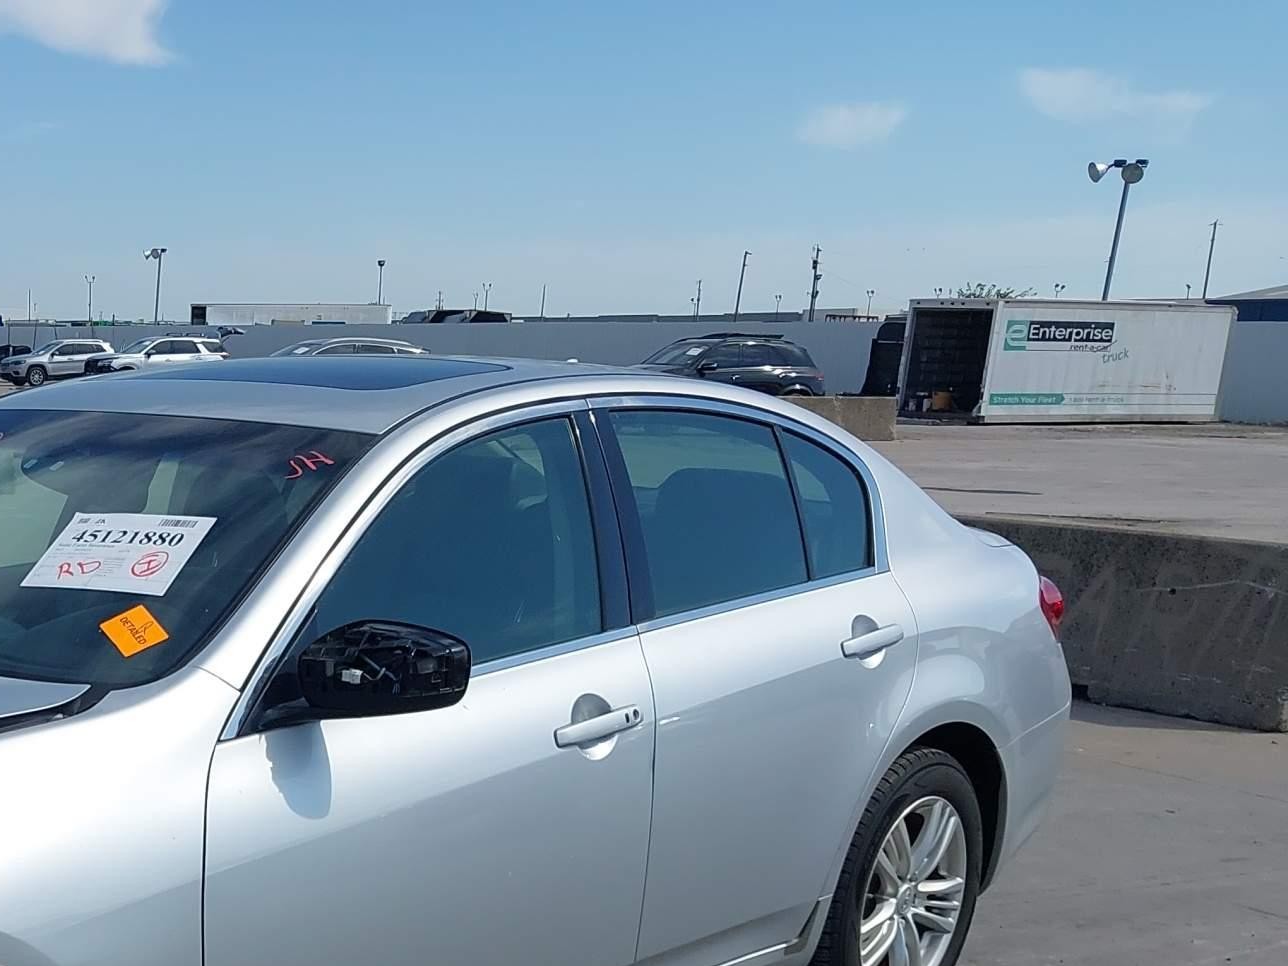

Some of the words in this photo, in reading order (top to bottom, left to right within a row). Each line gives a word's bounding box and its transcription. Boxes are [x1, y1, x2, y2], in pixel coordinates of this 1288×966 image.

[1029, 324, 1112, 341] Enterprise
[1102, 348, 1129, 363] truck
[72, 529, 185, 547] 45121880
